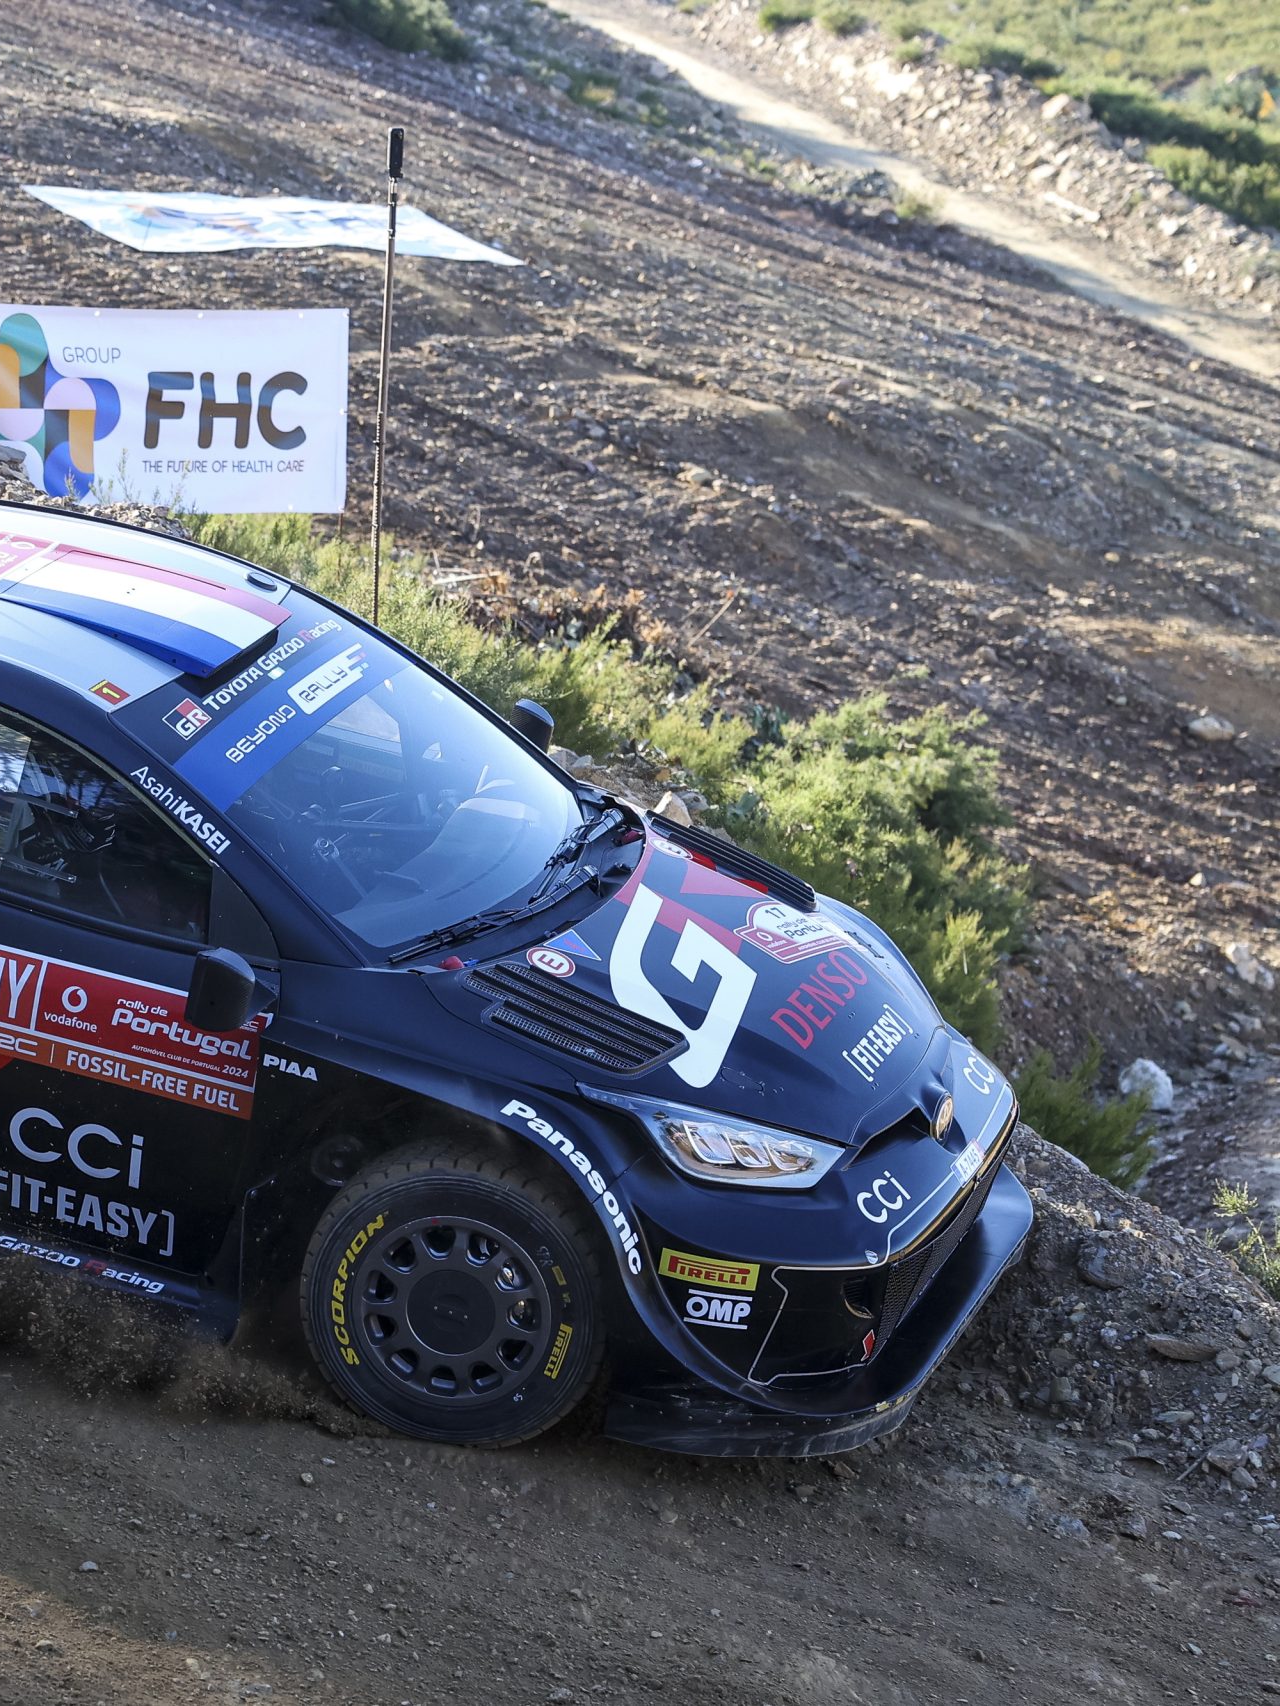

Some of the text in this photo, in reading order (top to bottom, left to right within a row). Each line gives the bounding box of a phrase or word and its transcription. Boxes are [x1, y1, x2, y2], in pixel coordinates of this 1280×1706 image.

[63, 347, 121, 365] GROUP
[143, 371, 308, 450] FHC
[142, 460, 304, 473] THE FUTURE OF HEALTH CARE
[175, 619, 343, 738] GR TOYOTA GAZOO Racing
[225, 666, 349, 764] BEYOND RALLY
[130, 765, 231, 855] AsahiKASEI
[765, 907, 786, 919] 17
[44, 1011, 98, 1033] vodafone
[117, 998, 168, 1017] rally de
[771, 951, 868, 1050] DENSO
[111, 1008, 252, 1061] Portugal
[66, 1049, 187, 1097] FOSSIL-FREE
[192, 1084, 240, 1112] FUEL
[131, 1044, 249, 1079] AUTOMÓVEL CLUB DE PORTUGAL 2024
[263, 1053, 318, 1082] PIAA
[500, 1100, 642, 1276] Panasonic
[83, 1260, 166, 1294] Racing
[331, 1213, 385, 1367] SCORPION
[668, 1254, 751, 1286] PIRELLI
[686, 1295, 752, 1323] OMP
[544, 1322, 574, 1380] PIRELLI
